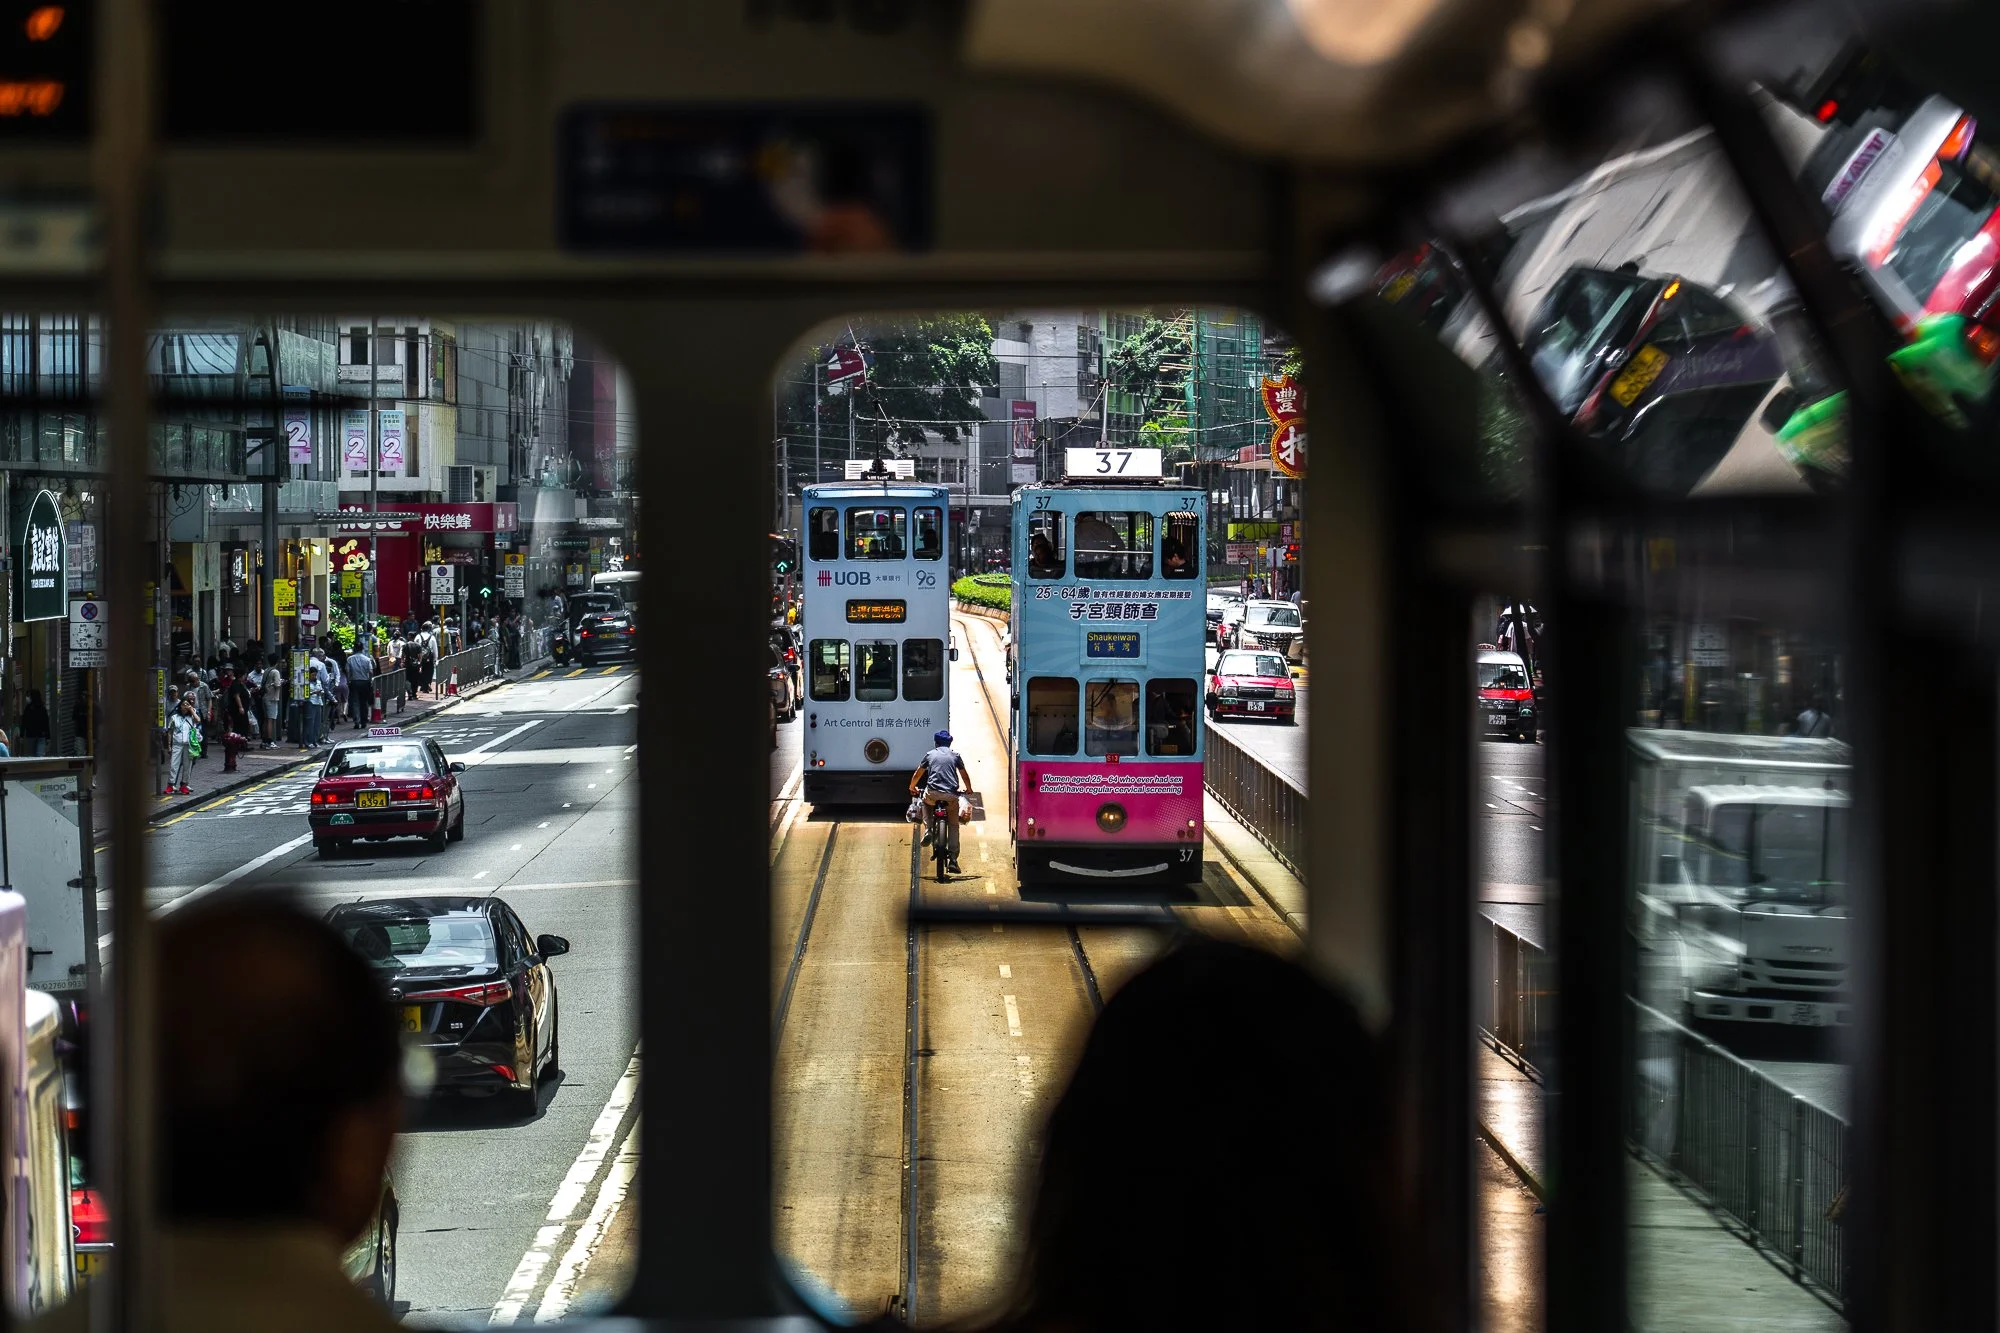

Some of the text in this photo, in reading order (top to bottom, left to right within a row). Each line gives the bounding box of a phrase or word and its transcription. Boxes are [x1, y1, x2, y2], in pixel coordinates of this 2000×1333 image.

[285, 420, 307, 447] 2
[347, 436, 365, 458] 2
[383, 436, 401, 458] 2
[1095, 451, 1132, 474] 37
[1035, 496, 1051, 510] 37
[1181, 497, 1197, 511] 37
[424, 513, 472, 530] 快樂蜂
[835, 571, 871, 586] UOB
[916, 569, 936, 586] 90
[1036, 587, 1051, 599] 25
[1061, 586, 1091, 600] 64歲
[1069, 602, 1159, 621] 子宮頸篩查
[95, 624, 102, 634] 7
[96, 638, 103, 648] 8
[1088, 633, 1137, 642] Shaukeiwan
[824, 718, 838, 728] Art
[840, 718, 873, 728] Central
[1043, 774, 1070, 783] Women
[1071, 775, 1091, 785] aged
[1119, 775, 1136, 783] who
[1154, 774, 1169, 783] had
[366, 791, 378, 800] UF
[1040, 784, 1183, 795] should have regular cervical screening
[361, 799, 385, 808] 8394
[1179, 849, 1194, 862] 37
